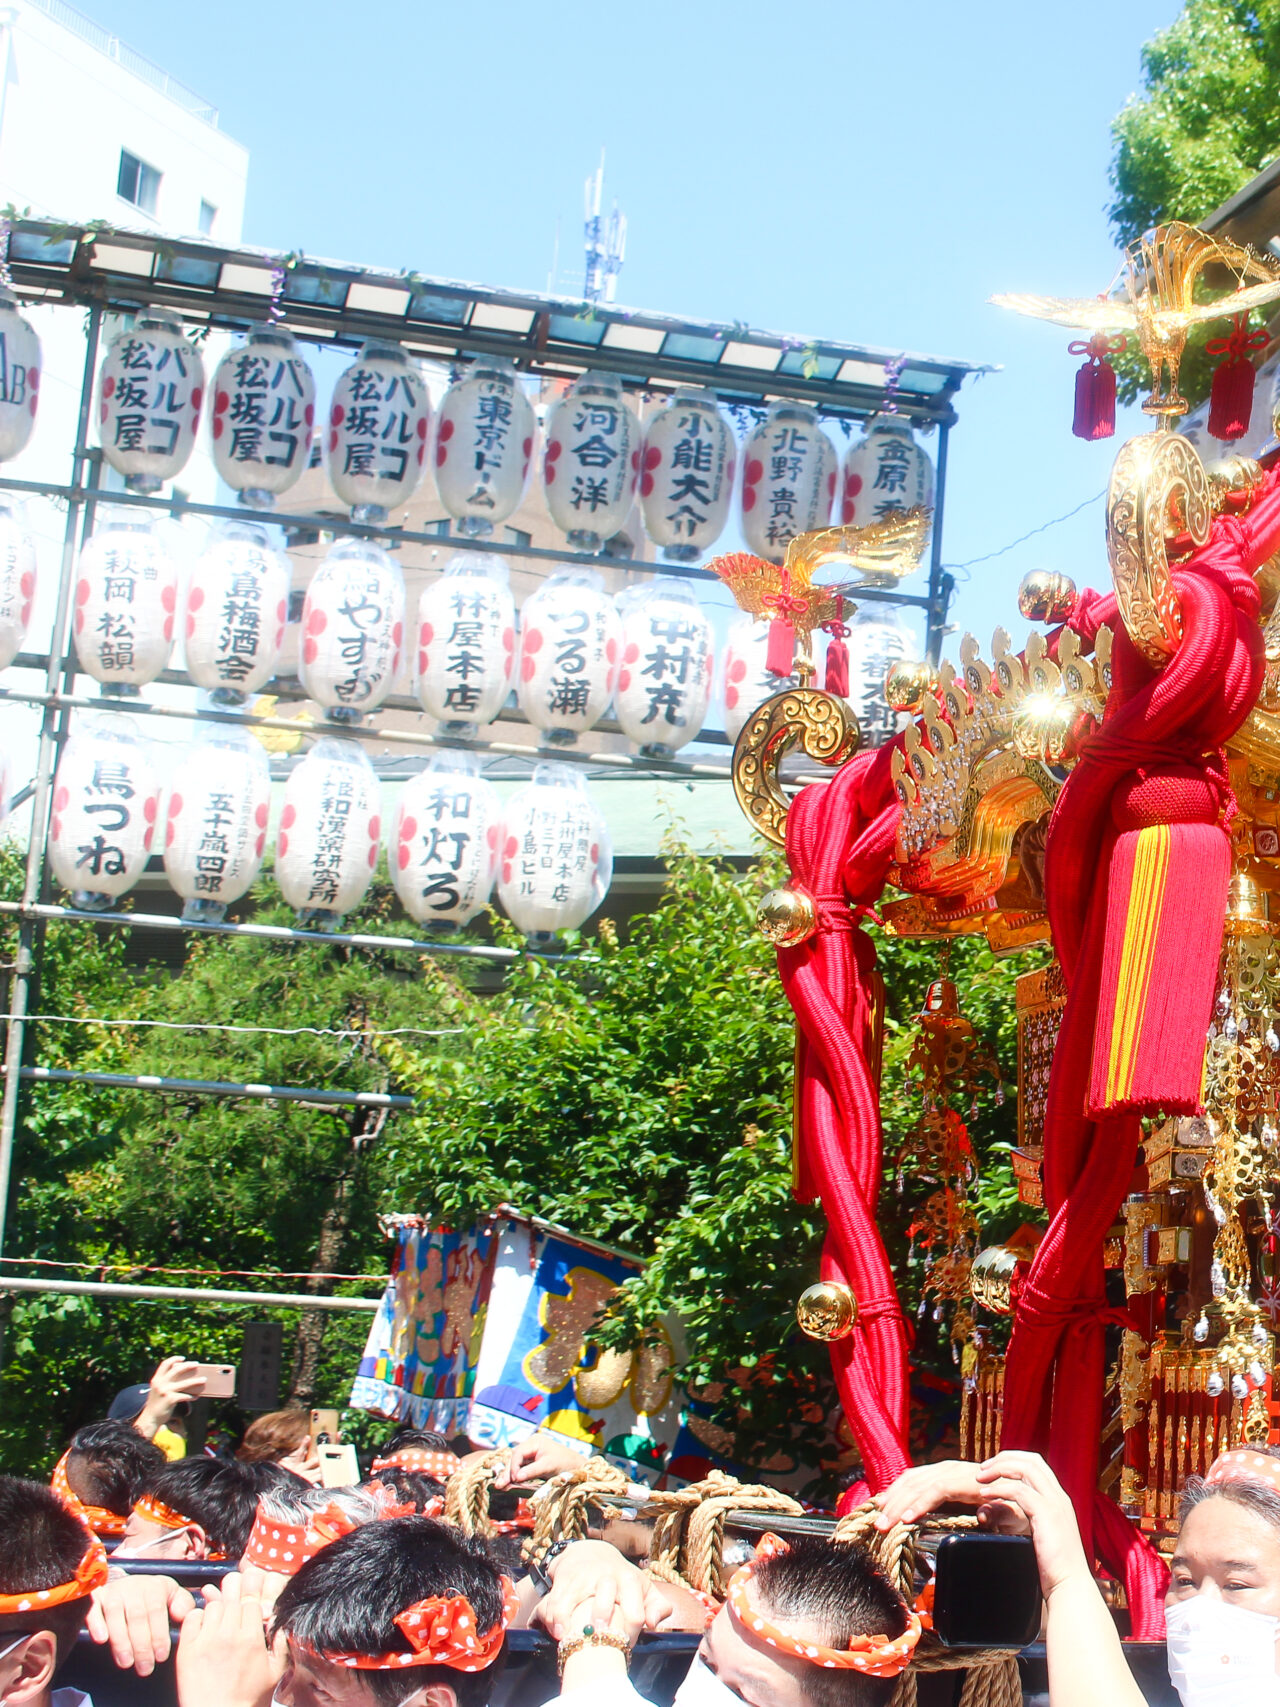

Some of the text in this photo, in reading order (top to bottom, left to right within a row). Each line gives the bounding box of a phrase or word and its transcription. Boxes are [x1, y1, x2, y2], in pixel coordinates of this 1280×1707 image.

[114, 338, 153, 454] 松坂屋
[147, 346, 194, 458] パルコ
[229, 353, 270, 464] 松坂屋
[264, 357, 306, 468] パルコ
[343, 368, 383, 478] 松坂屋
[380, 373, 424, 483] パルコ
[466, 396, 512, 510] 東京ドーム
[570, 401, 619, 514] 河合洋
[666, 411, 714, 538] 小能大介
[443, 590, 490, 713] 林屋本店
[546, 609, 592, 718] つる瀬
[75, 759, 137, 876] 鳥つね
[193, 792, 235, 893] 五十嵐四郎
[307, 766, 354, 904] 姫和漢薬研究所
[419, 785, 472, 912] 和灯ろ
[519, 807, 538, 896] 小島ビル
